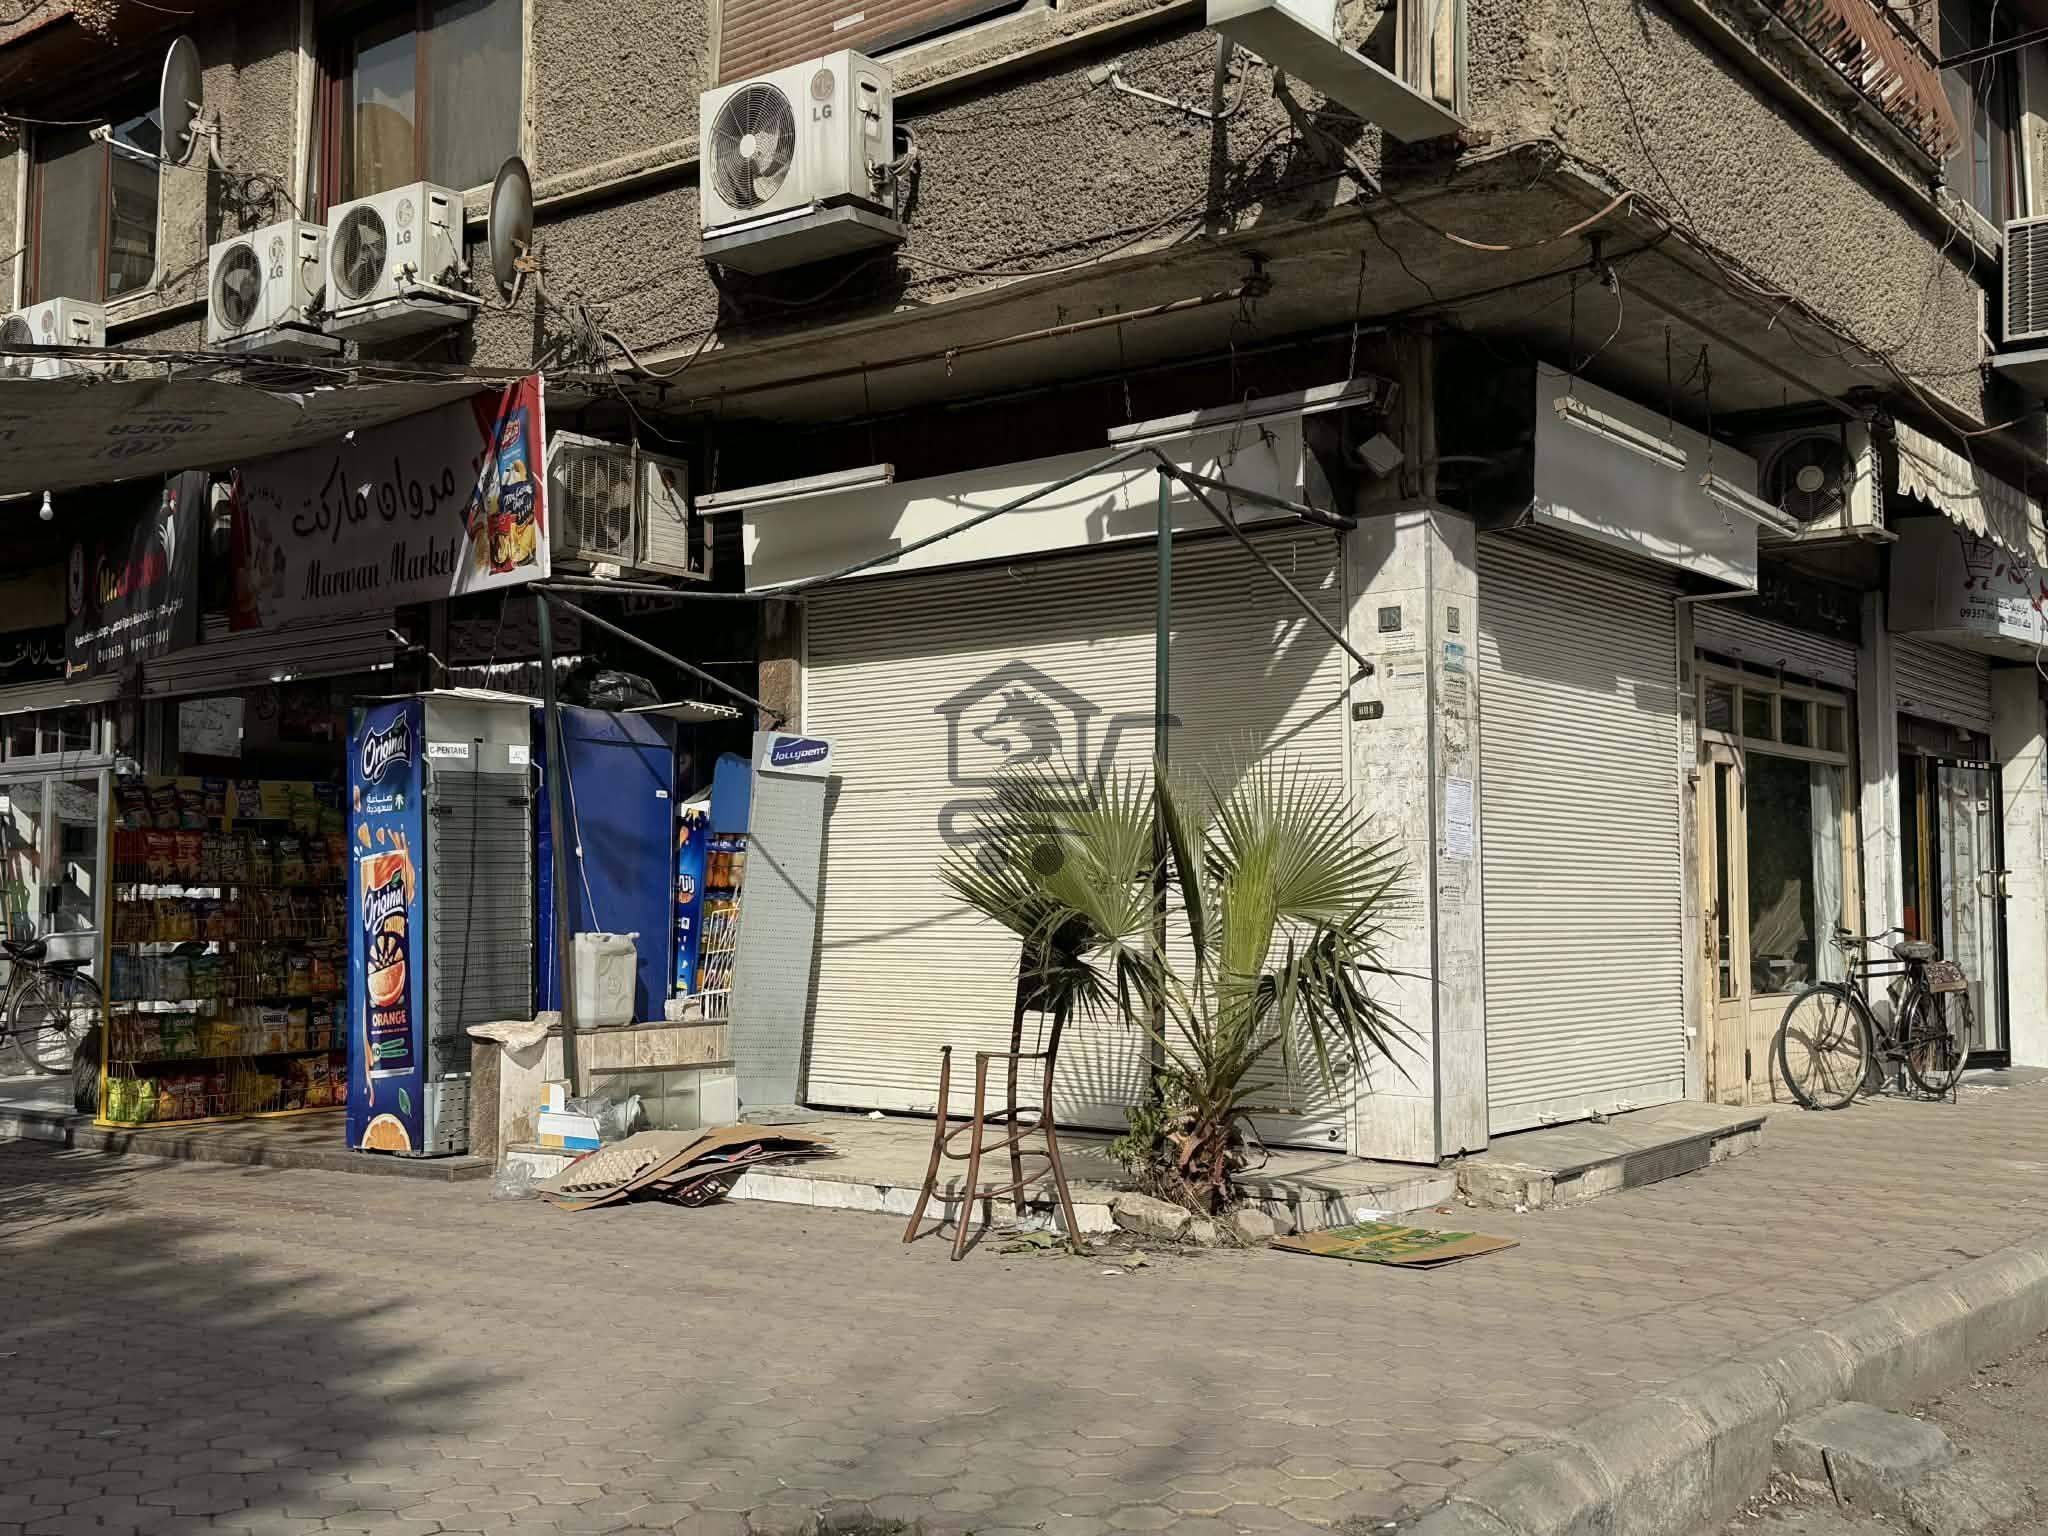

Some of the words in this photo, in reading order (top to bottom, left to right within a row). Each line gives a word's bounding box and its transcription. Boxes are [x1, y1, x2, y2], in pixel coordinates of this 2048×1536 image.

[813, 104, 832, 122] LG
[396, 230, 411, 246] LG
[269, 266, 283, 280] LG
[292, 455, 368, 544] ماركت
[376, 456, 456, 522] مروان
[302, 559, 380, 601] Marwan
[386, 536, 458, 585] Market
[364, 730, 408, 780] Original
[429, 746, 468, 756] C-PENTANE
[365, 884, 405, 935] Original
[372, 1010, 407, 1027] ORANGE
